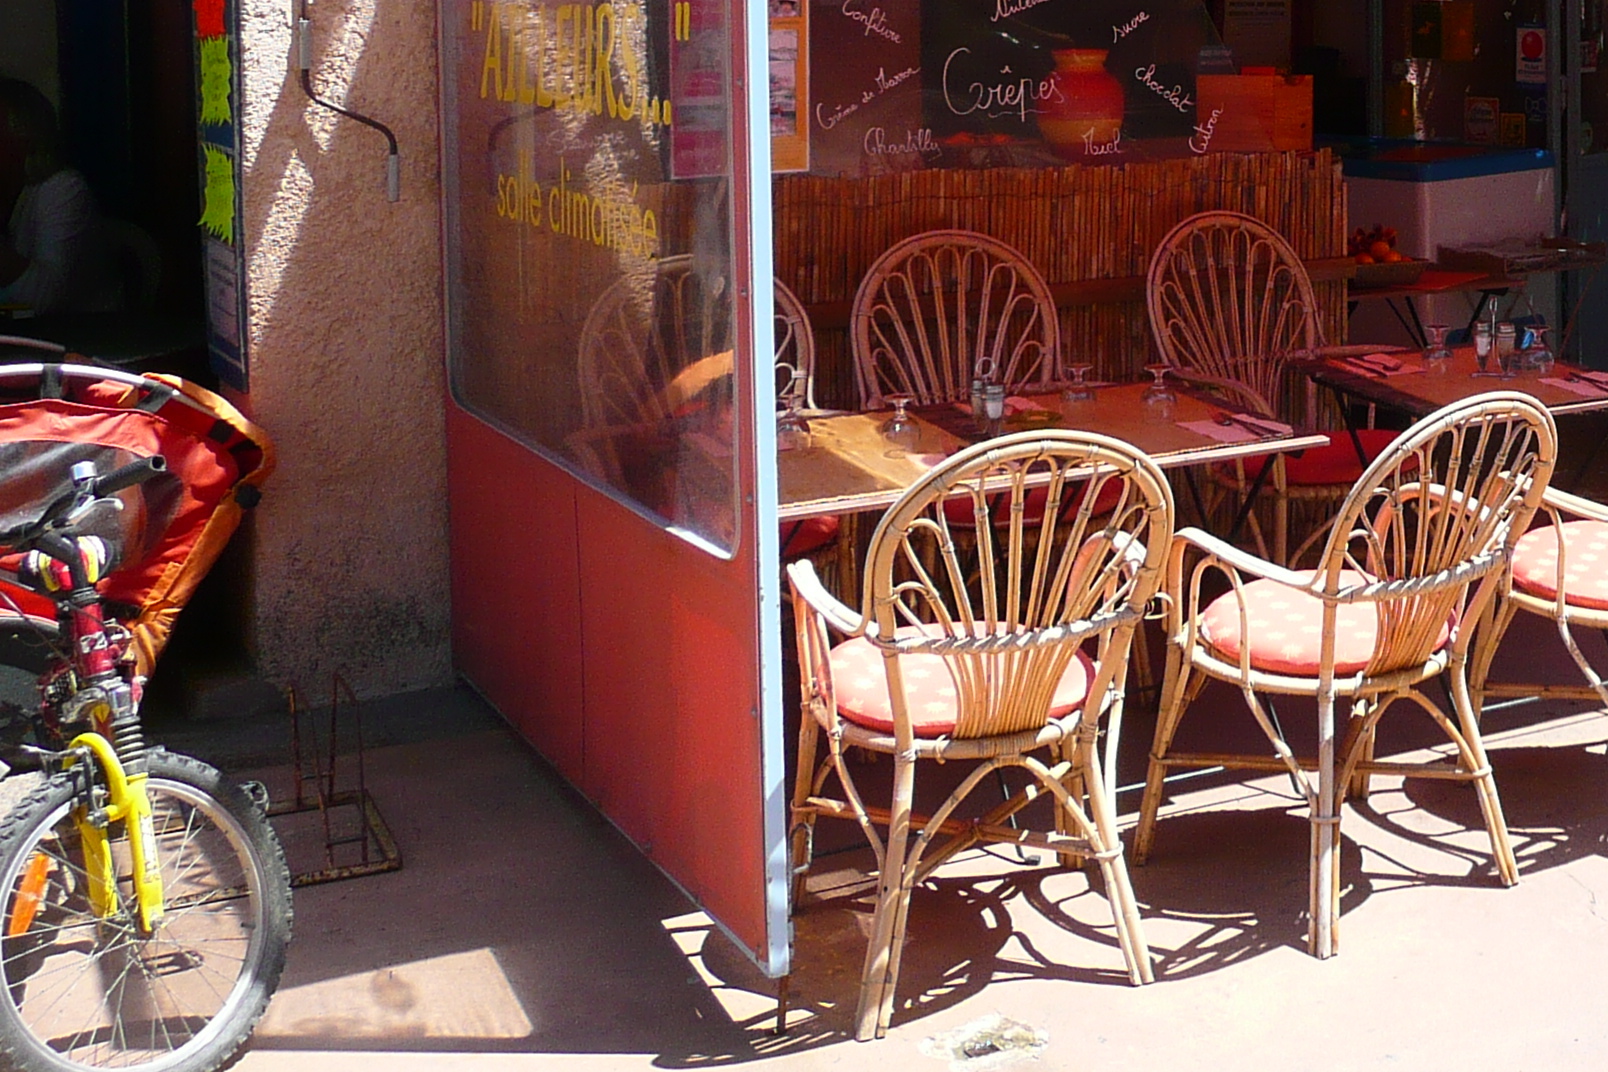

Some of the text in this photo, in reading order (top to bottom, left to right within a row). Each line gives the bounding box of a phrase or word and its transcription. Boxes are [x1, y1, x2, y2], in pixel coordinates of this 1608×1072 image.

[943, 47, 1064, 123] Crêpes
[864, 127, 943, 162] Chantilly
[1081, 126, 1124, 155] Miel
[1188, 102, 1224, 154] Citron
[498, 150, 656, 261] salle climatisée
